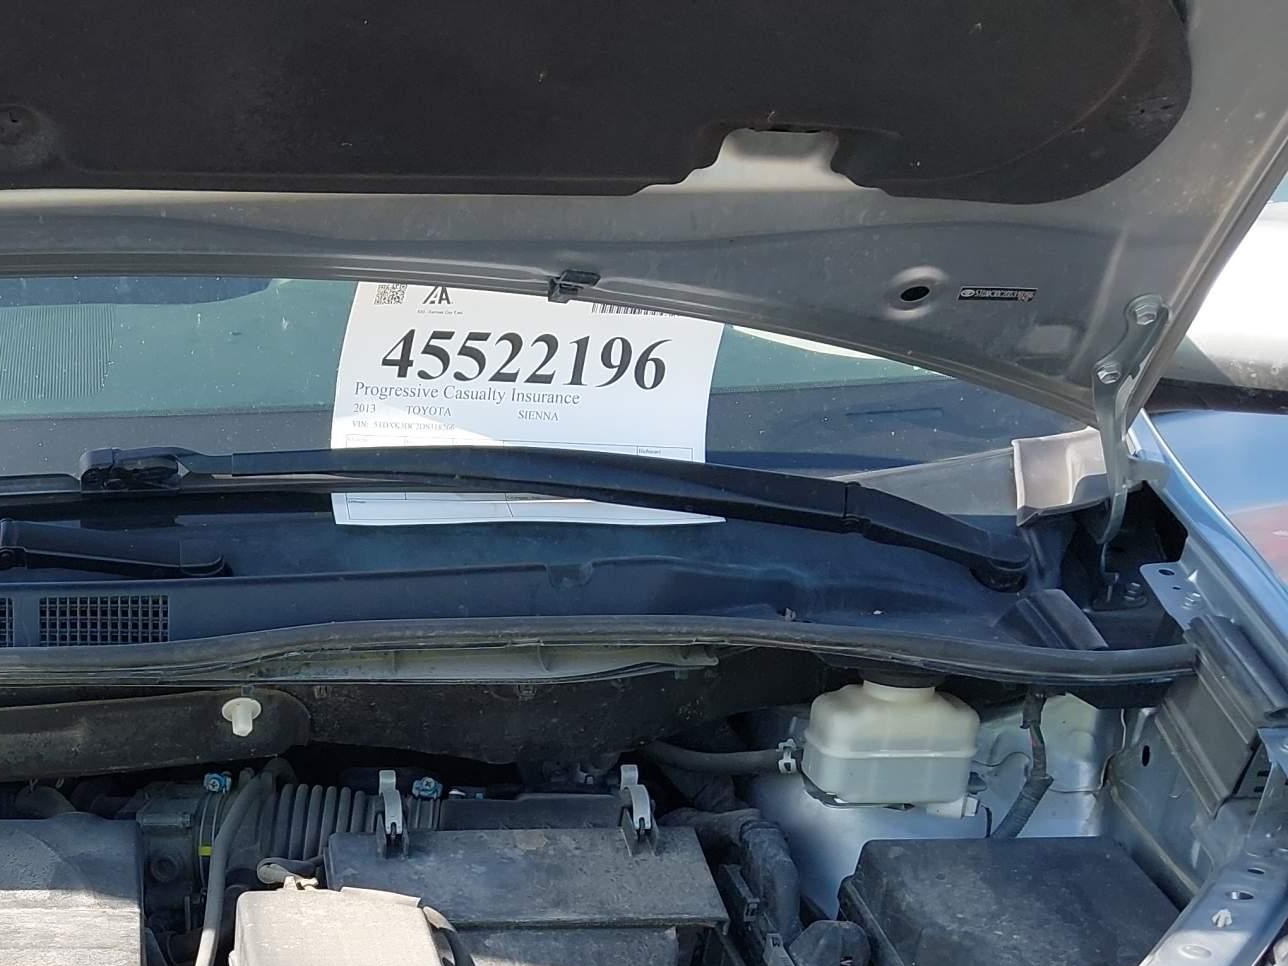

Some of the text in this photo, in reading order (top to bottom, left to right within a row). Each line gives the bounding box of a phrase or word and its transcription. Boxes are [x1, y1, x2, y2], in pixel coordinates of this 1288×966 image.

[381, 328, 673, 390] 45522196
[355, 381, 580, 405] Progressive Casualty Insurance
[353, 403, 559, 421] 2013 TOYOTA SIENNA
